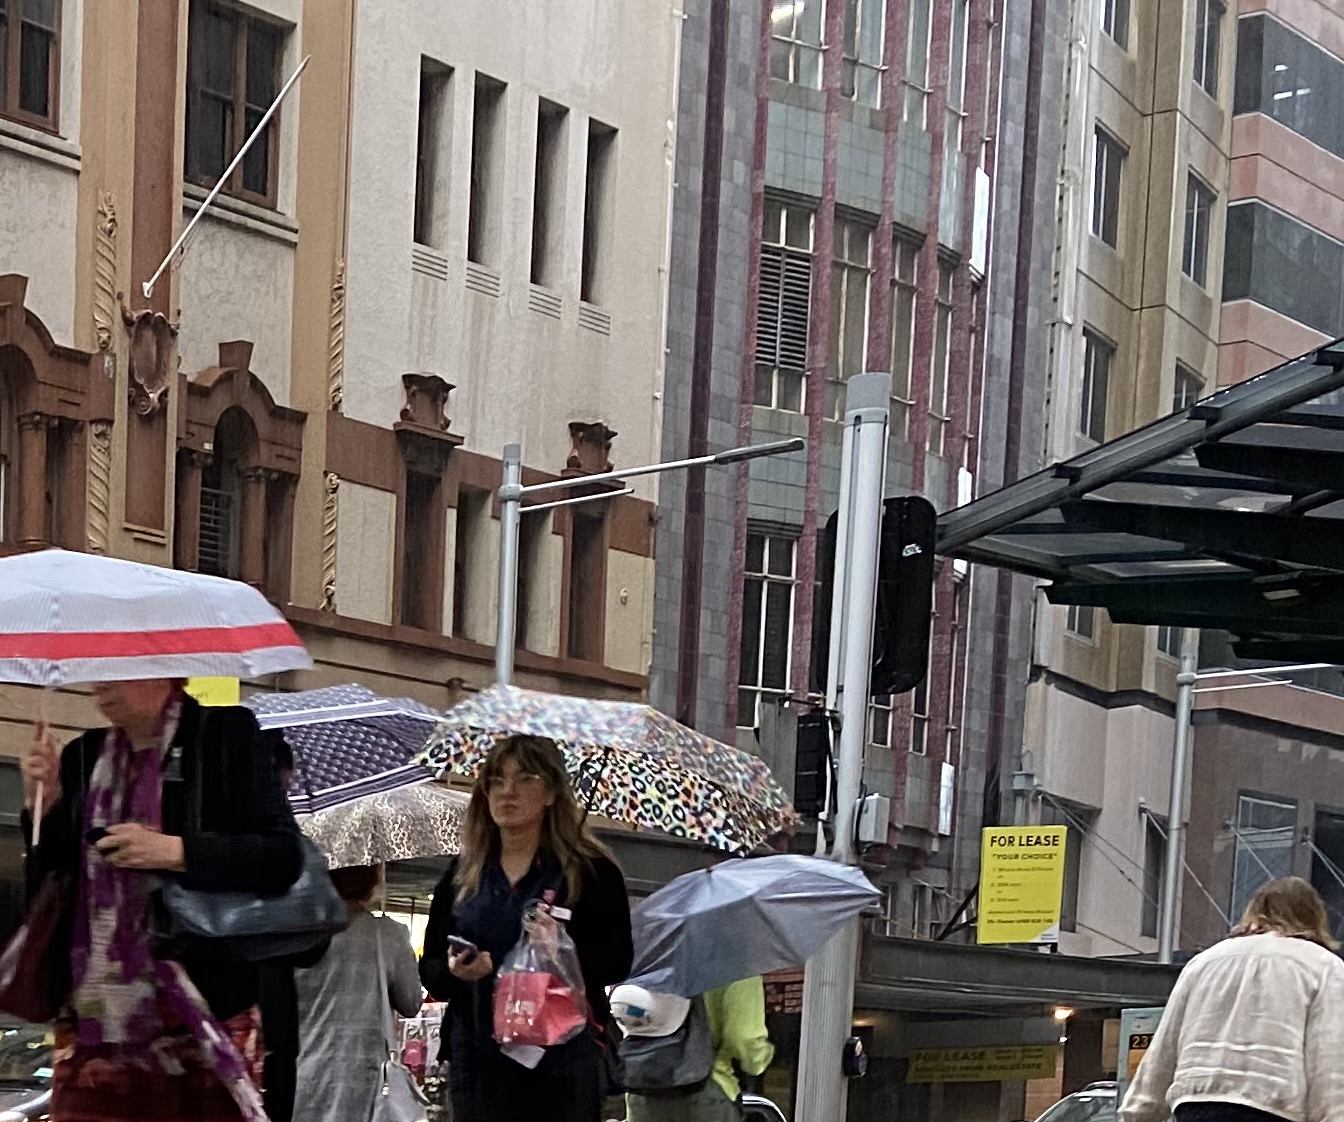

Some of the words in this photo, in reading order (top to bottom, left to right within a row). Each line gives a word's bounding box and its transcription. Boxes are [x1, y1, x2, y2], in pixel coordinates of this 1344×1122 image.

[990, 835, 1015, 847] FOR
[1018, 835, 1060, 846] LEASE
[1132, 1035, 1155, 1048] 23
[914, 1052, 941, 1061] FOR
[944, 1050, 987, 1061] LEASE
